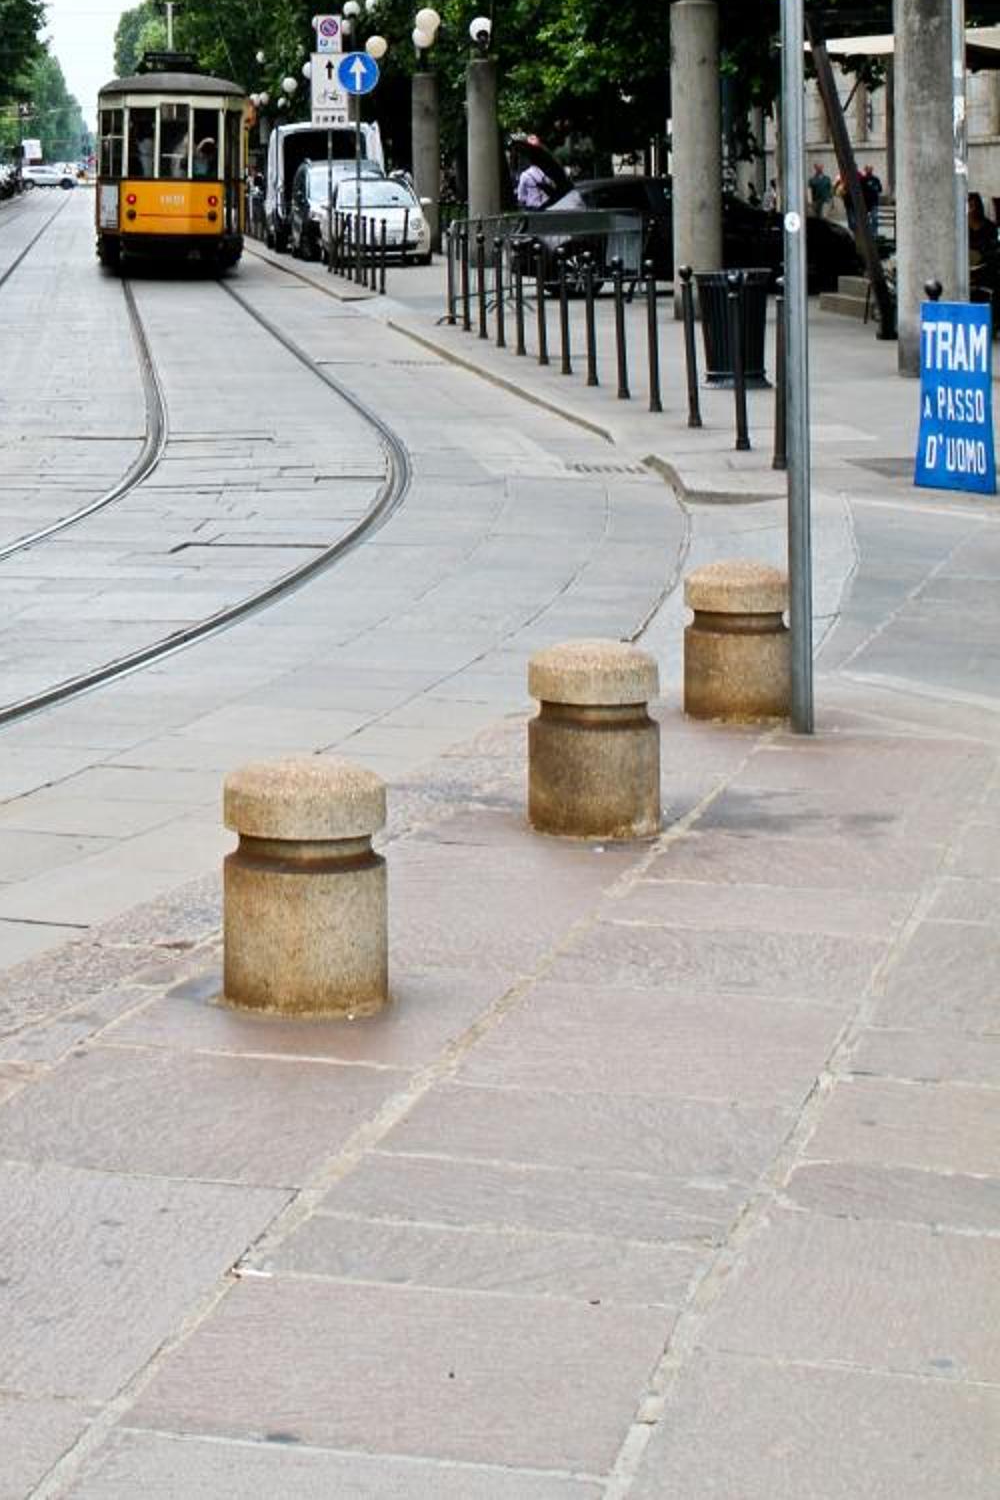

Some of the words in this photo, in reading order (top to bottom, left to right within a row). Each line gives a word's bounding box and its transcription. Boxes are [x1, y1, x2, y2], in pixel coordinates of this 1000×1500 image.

[922, 321, 988, 373] TRAM
[924, 396, 933, 419] A
[937, 385, 985, 424] PASSO
